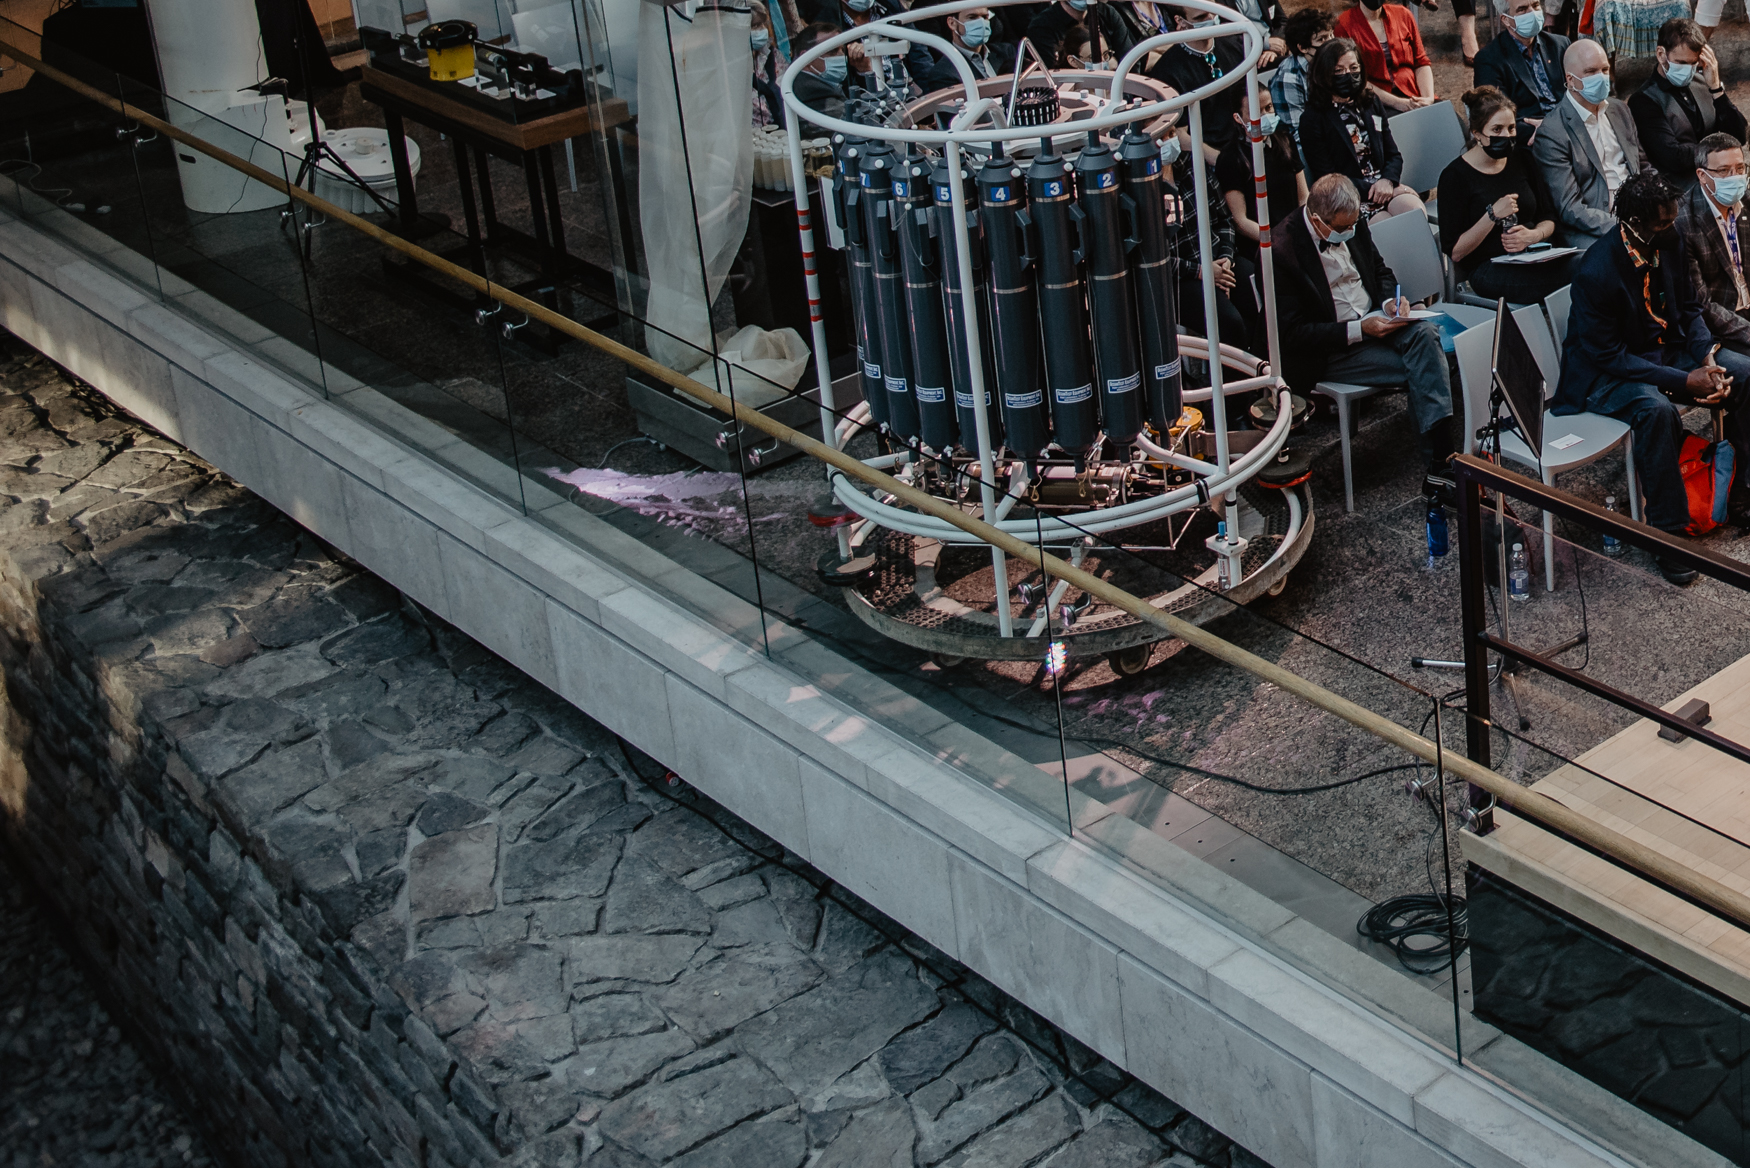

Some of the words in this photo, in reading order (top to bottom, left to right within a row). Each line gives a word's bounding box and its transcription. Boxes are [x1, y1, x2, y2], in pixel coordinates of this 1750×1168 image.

[1150, 161, 1158, 173] 1
[860, 172, 867, 186] 7
[1102, 173, 1112, 187] 2
[894, 182, 904, 196] 6
[940, 187, 950, 200] 5
[995, 187, 1006, 201] 4
[1050, 182, 1061, 195] 3
